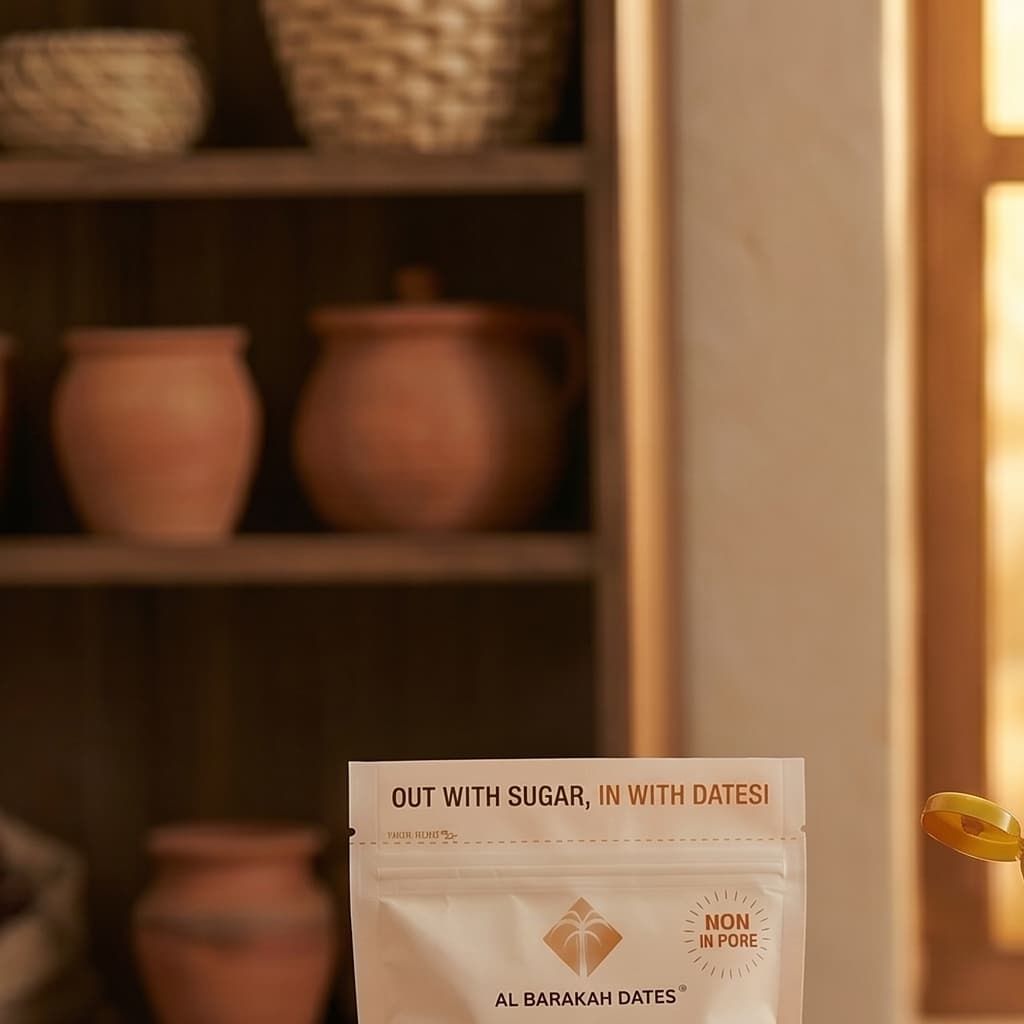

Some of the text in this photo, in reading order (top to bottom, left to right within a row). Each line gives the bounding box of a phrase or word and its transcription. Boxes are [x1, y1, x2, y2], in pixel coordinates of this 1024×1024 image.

[391, 785, 436, 809] OUT
[443, 785, 501, 808] WITH
[507, 784, 592, 811] SUGAR,
[599, 784, 621, 807] IN
[627, 783, 685, 807] WITH
[704, 913, 750, 931] NON
[699, 933, 759, 949] IN PORE
[494, 992, 519, 1008] AL
[522, 990, 613, 1008] BARAKAH
